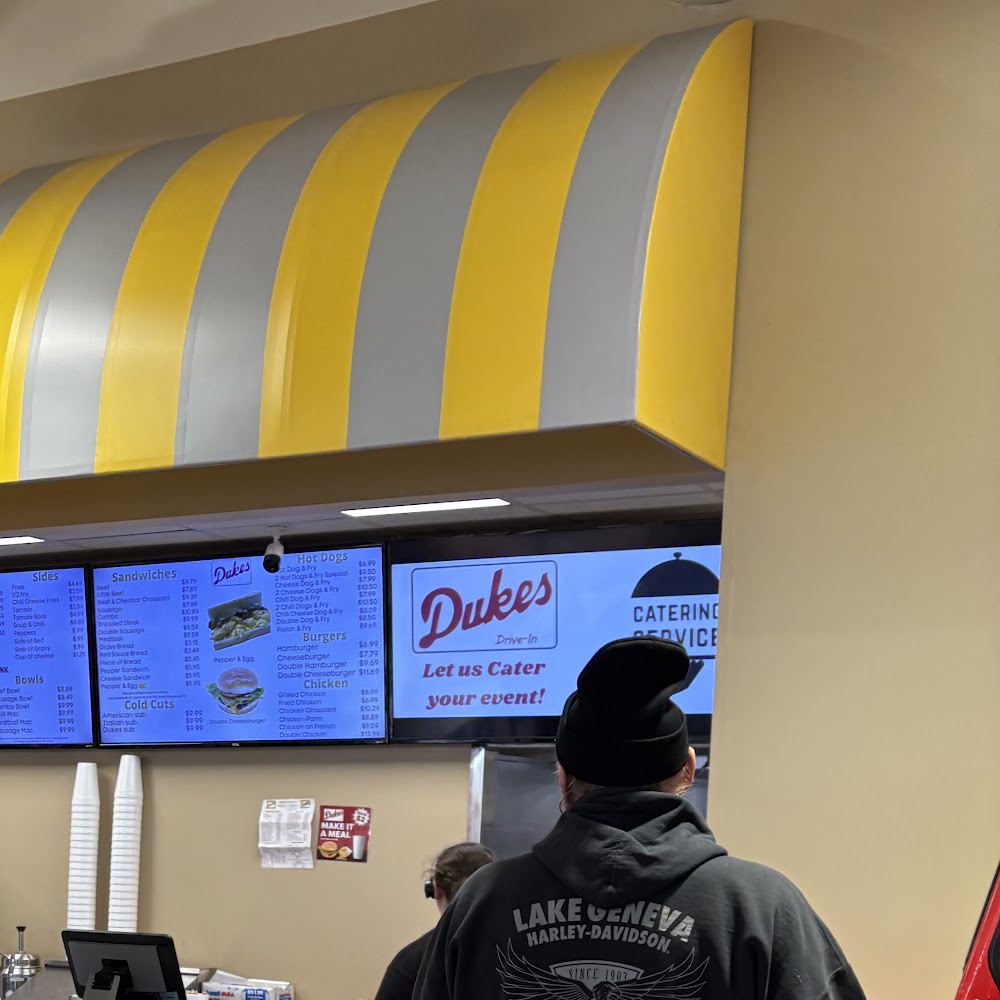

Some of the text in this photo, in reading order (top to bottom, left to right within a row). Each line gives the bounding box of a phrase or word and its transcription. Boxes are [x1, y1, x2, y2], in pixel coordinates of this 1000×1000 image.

[297, 553, 348, 564] Hot Dogs
[33, 572, 58, 582] Sides
[112, 569, 177, 582] Sandwiches
[214, 562, 250, 585] Dukes
[419, 568, 552, 649] Dukes
[303, 632, 346, 643] Burgers
[496, 634, 538, 645] Drive-In
[423, 661, 546, 678] Let us Cater
[15, 675, 44, 684] Bowls
[304, 679, 348, 688] Chicken
[426, 688, 546, 710] your event!
[125, 700, 175, 710] Cold Cuts
[512, 898, 583, 932] LAKE
[569, 968, 598, 980] SINCE
